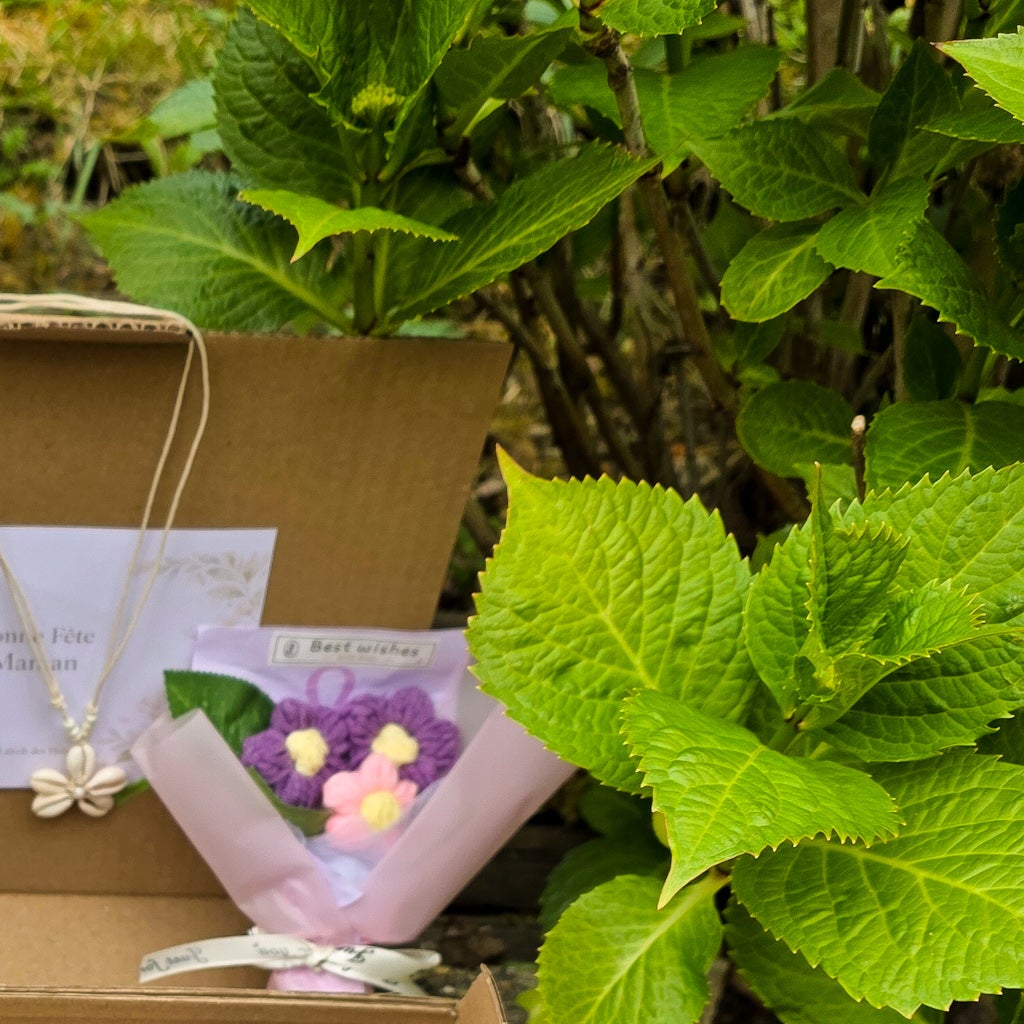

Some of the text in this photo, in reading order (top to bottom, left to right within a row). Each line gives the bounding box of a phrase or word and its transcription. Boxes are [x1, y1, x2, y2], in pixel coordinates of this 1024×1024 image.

[52, 628, 95, 644] Fête
[310, 640, 419, 657] Best wishes
